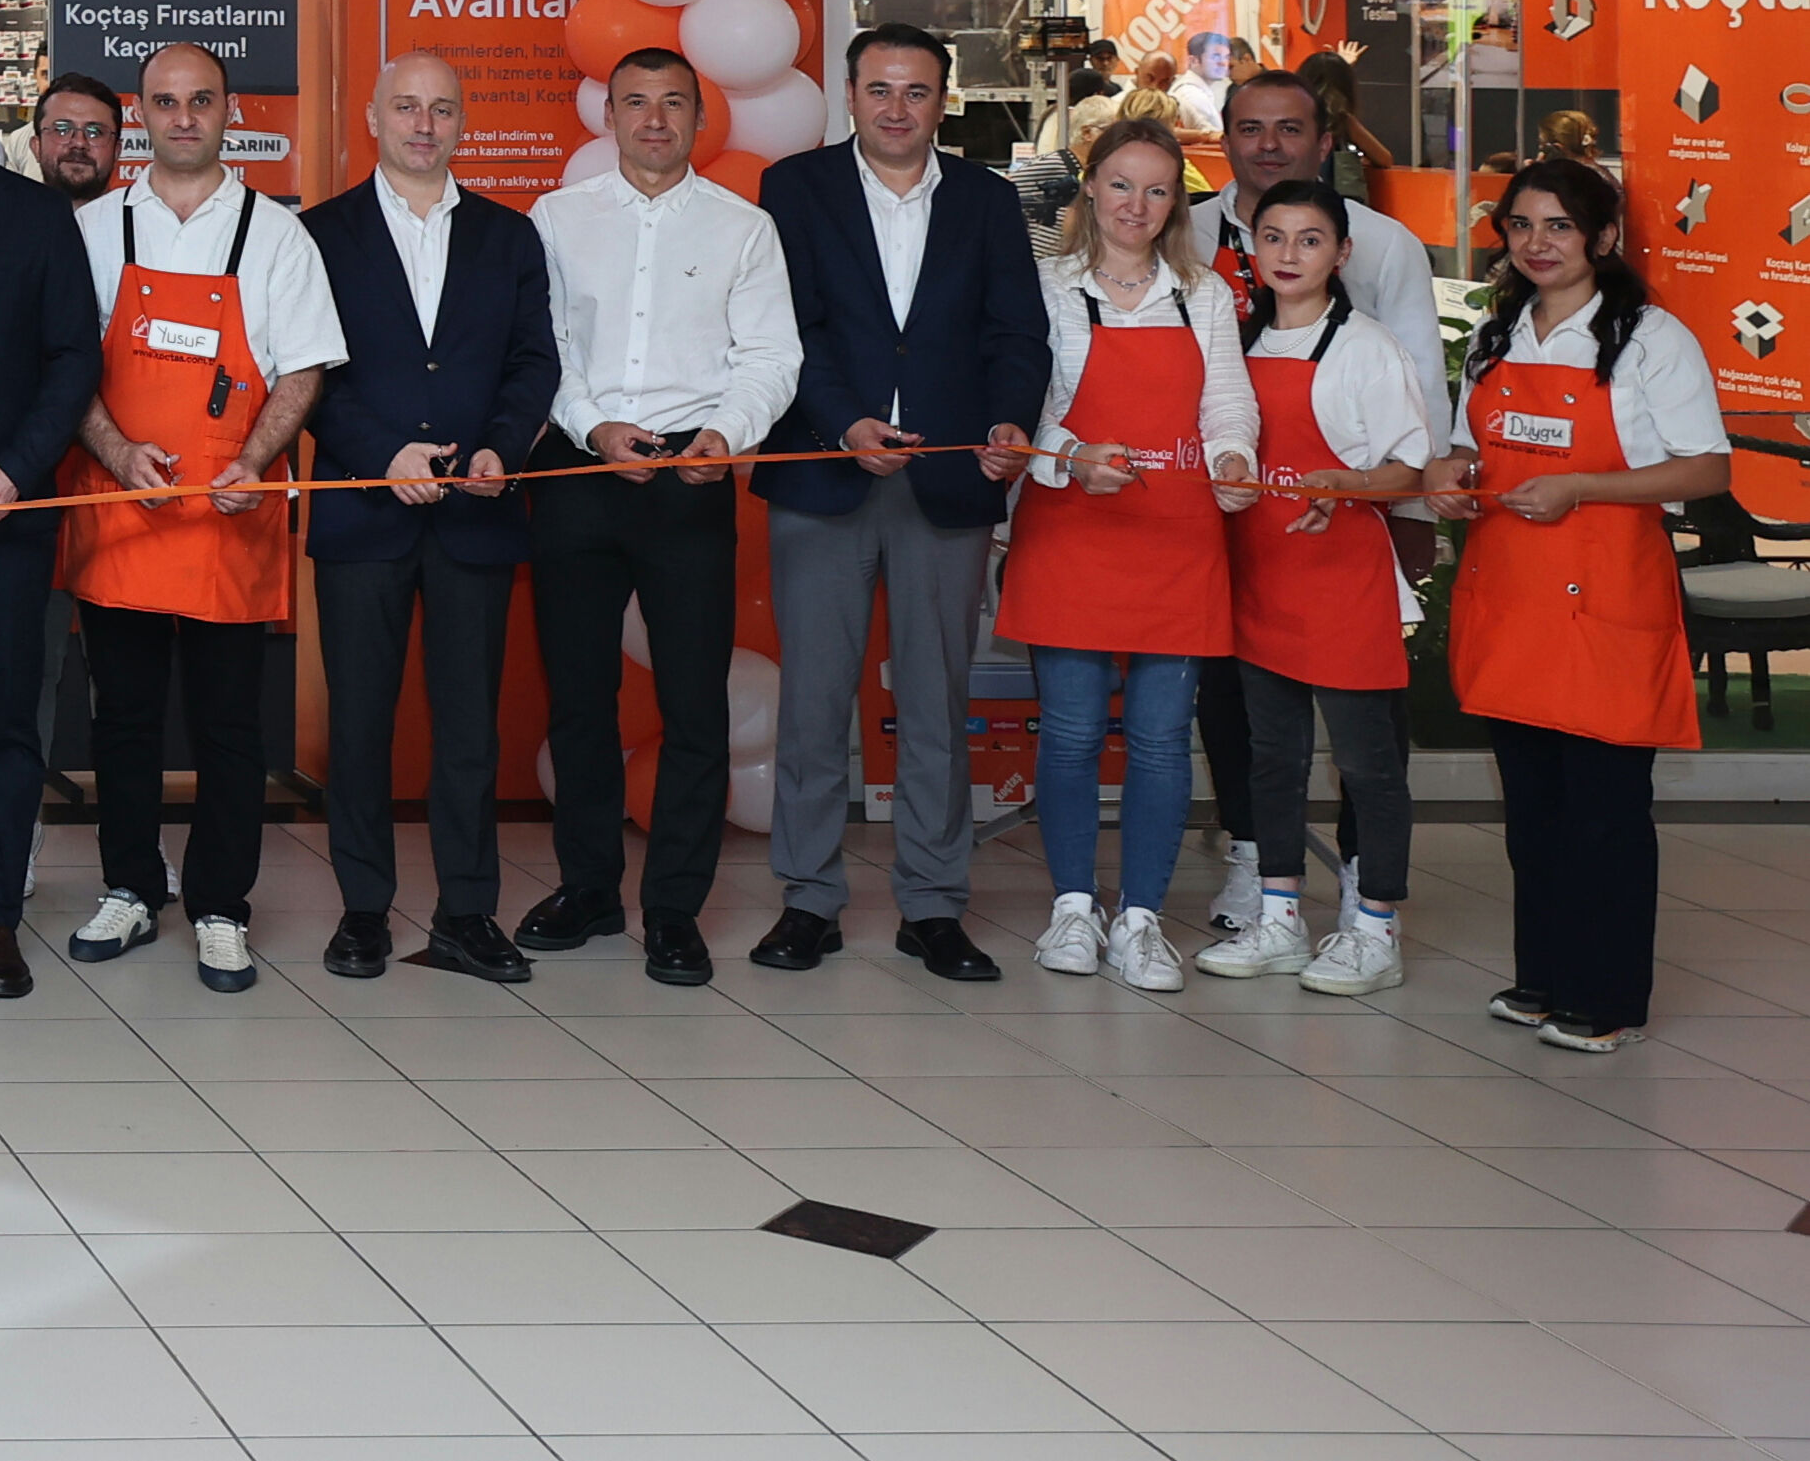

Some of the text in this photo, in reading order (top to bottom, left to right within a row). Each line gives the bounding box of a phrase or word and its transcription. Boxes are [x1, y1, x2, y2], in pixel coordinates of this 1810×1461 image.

[65, 3, 285, 30] Koçtaş Fırsatlarını
[470, 91, 530, 105] avantaj
[474, 130, 496, 141] özel
[499, 130, 538, 141] indirim
[540, 132, 554, 141] ve
[479, 146, 528, 156] kazanma
[530, 146, 563, 156] fırsatı
[456, 175, 555, 189] vantajlı nakliye ve
[1509, 415, 1563, 443] Duygu
